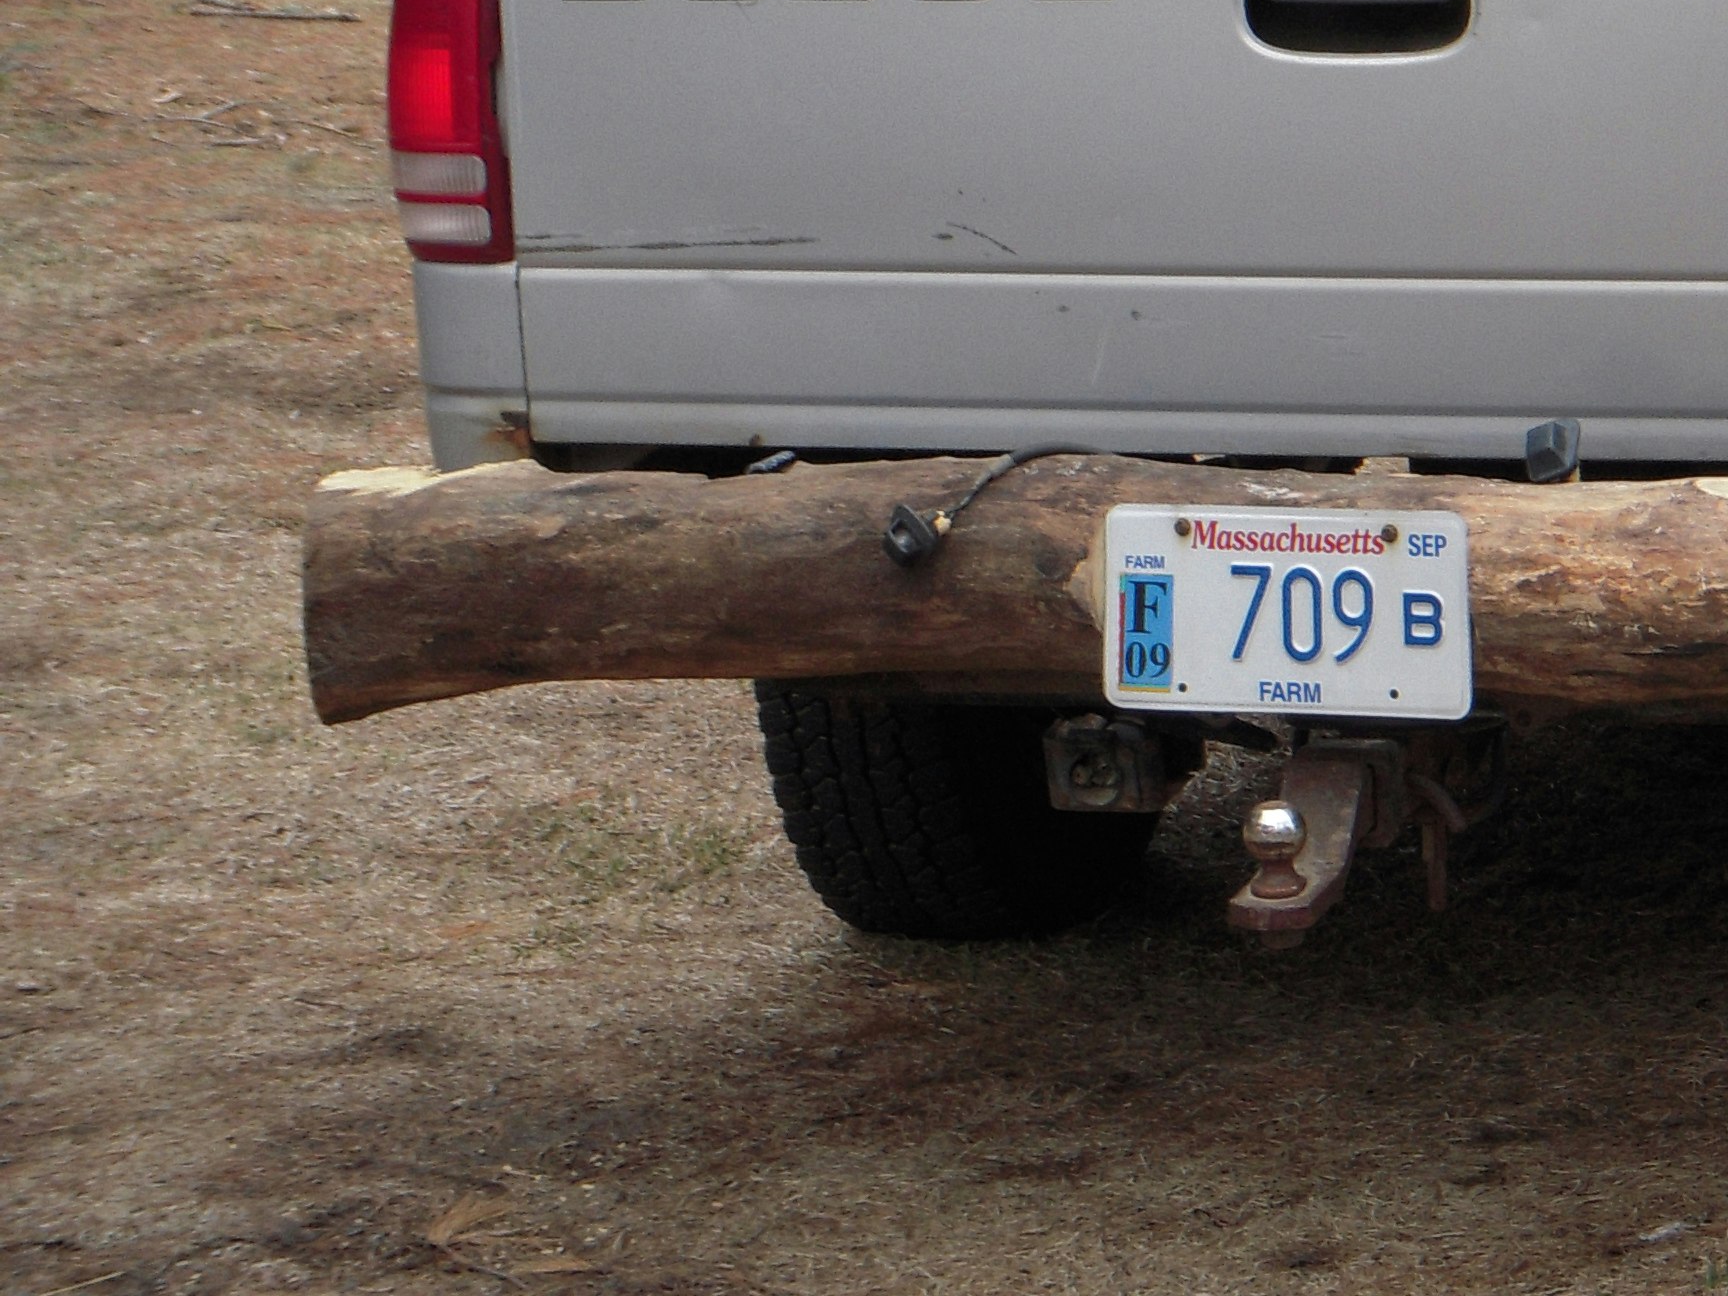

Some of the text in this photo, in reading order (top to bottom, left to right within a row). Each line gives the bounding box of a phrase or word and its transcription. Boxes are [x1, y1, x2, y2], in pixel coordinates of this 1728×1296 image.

[1191, 520, 1385, 555] Massachusetts
[1408, 533, 1447, 558] SEP
[1125, 555, 1165, 569] FARM
[1126, 580, 1168, 634] F
[1230, 564, 1444, 664] 709 B
[1125, 641, 1171, 678] 09
[1259, 681, 1322, 704] FARM
